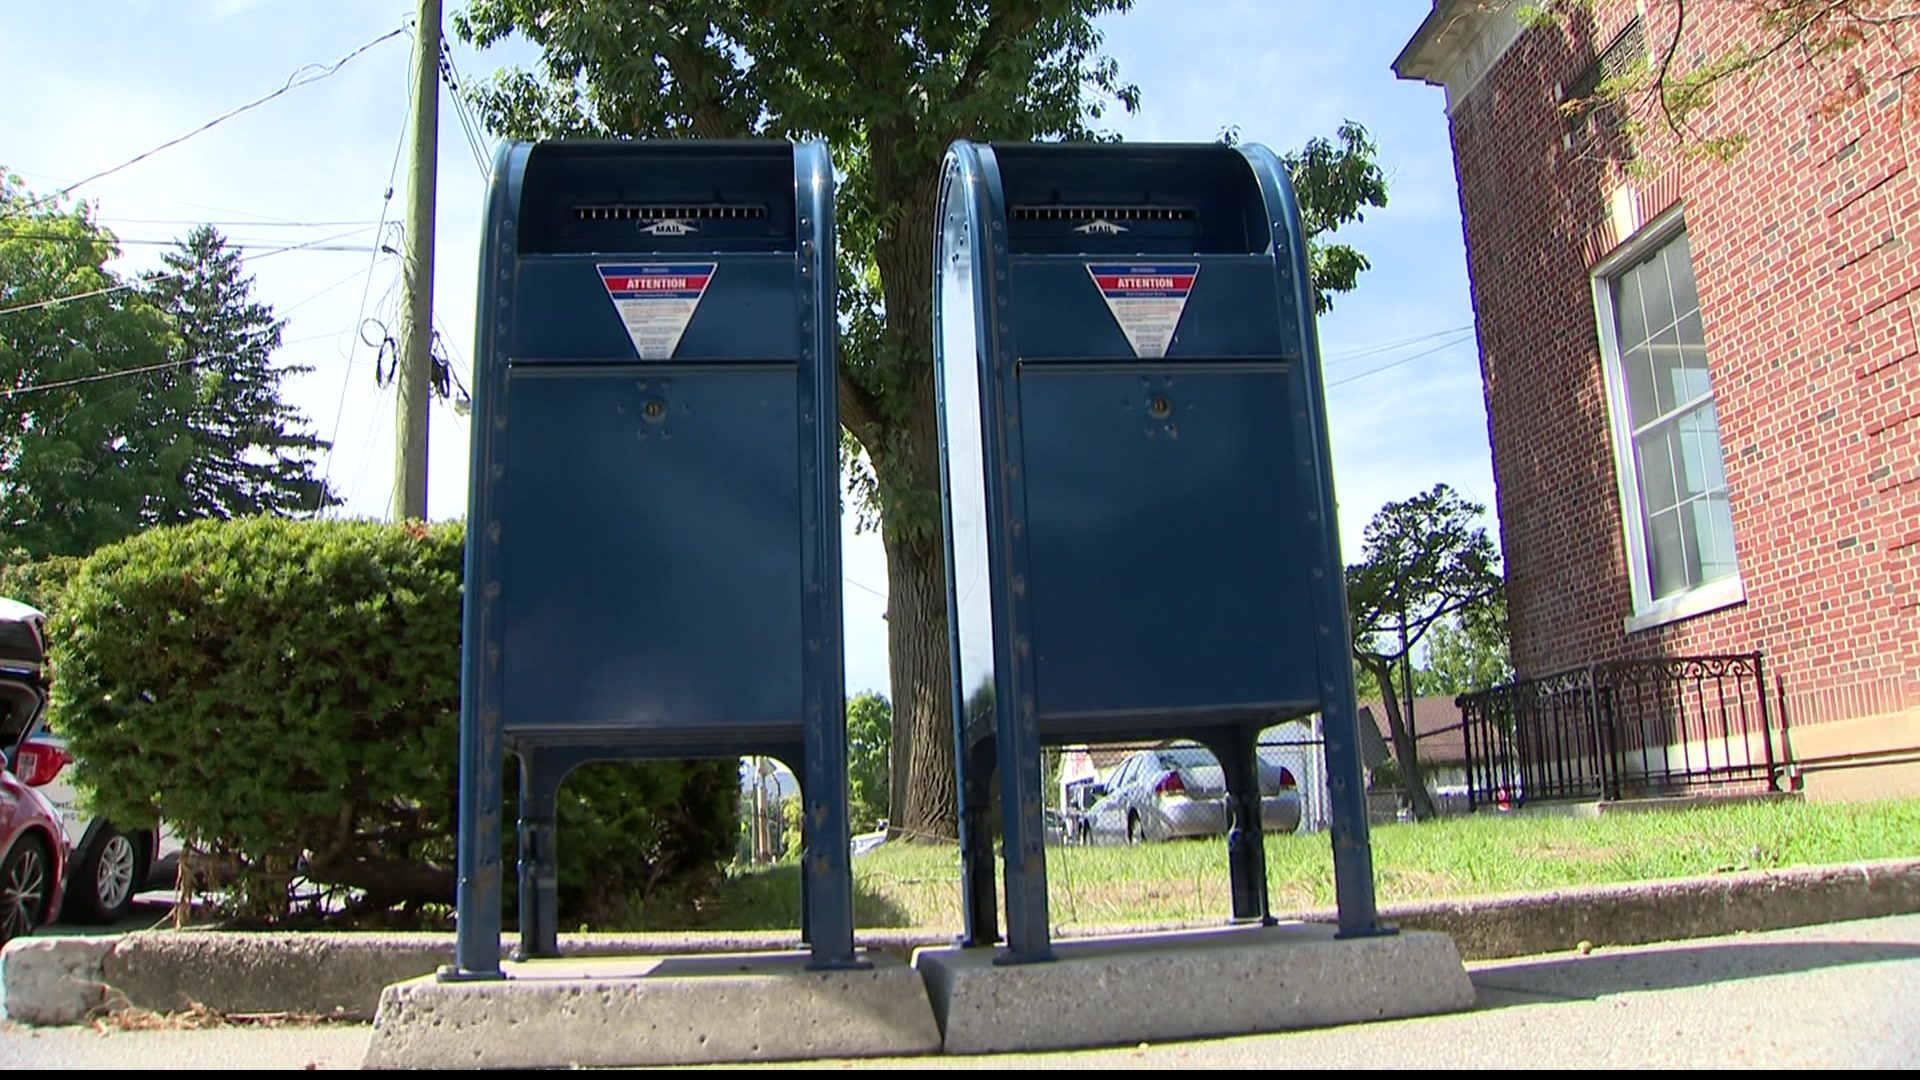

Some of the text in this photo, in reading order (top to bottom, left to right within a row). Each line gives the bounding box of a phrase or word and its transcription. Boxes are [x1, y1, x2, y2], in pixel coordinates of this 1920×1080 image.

[655, 225, 682, 233] MAIL
[1088, 224, 1113, 233] MAIL
[626, 278, 686, 289] ATTENTION
[1117, 278, 1174, 289] ATTENTION
